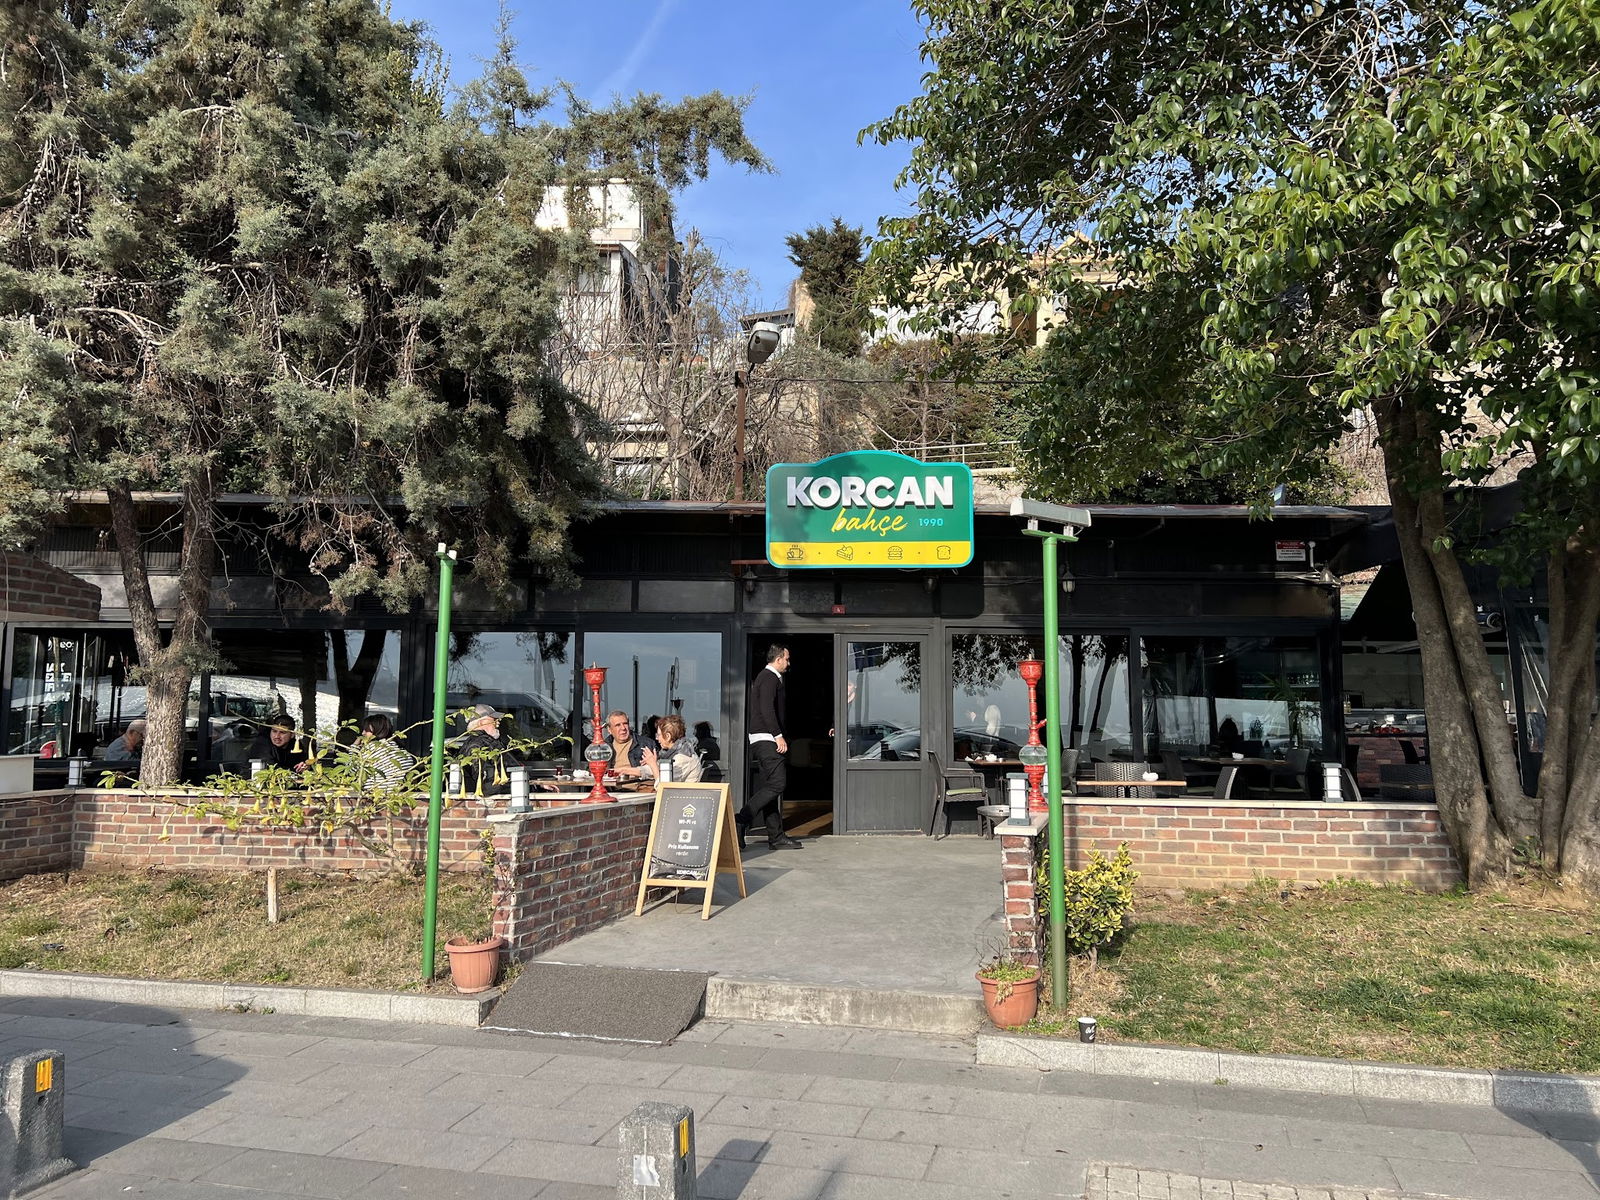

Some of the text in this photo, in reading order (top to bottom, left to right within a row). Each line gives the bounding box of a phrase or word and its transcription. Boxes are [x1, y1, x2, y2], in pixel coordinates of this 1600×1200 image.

[786, 475, 954, 508] KORCAN
[831, 507, 944, 536] bahçe 1990
